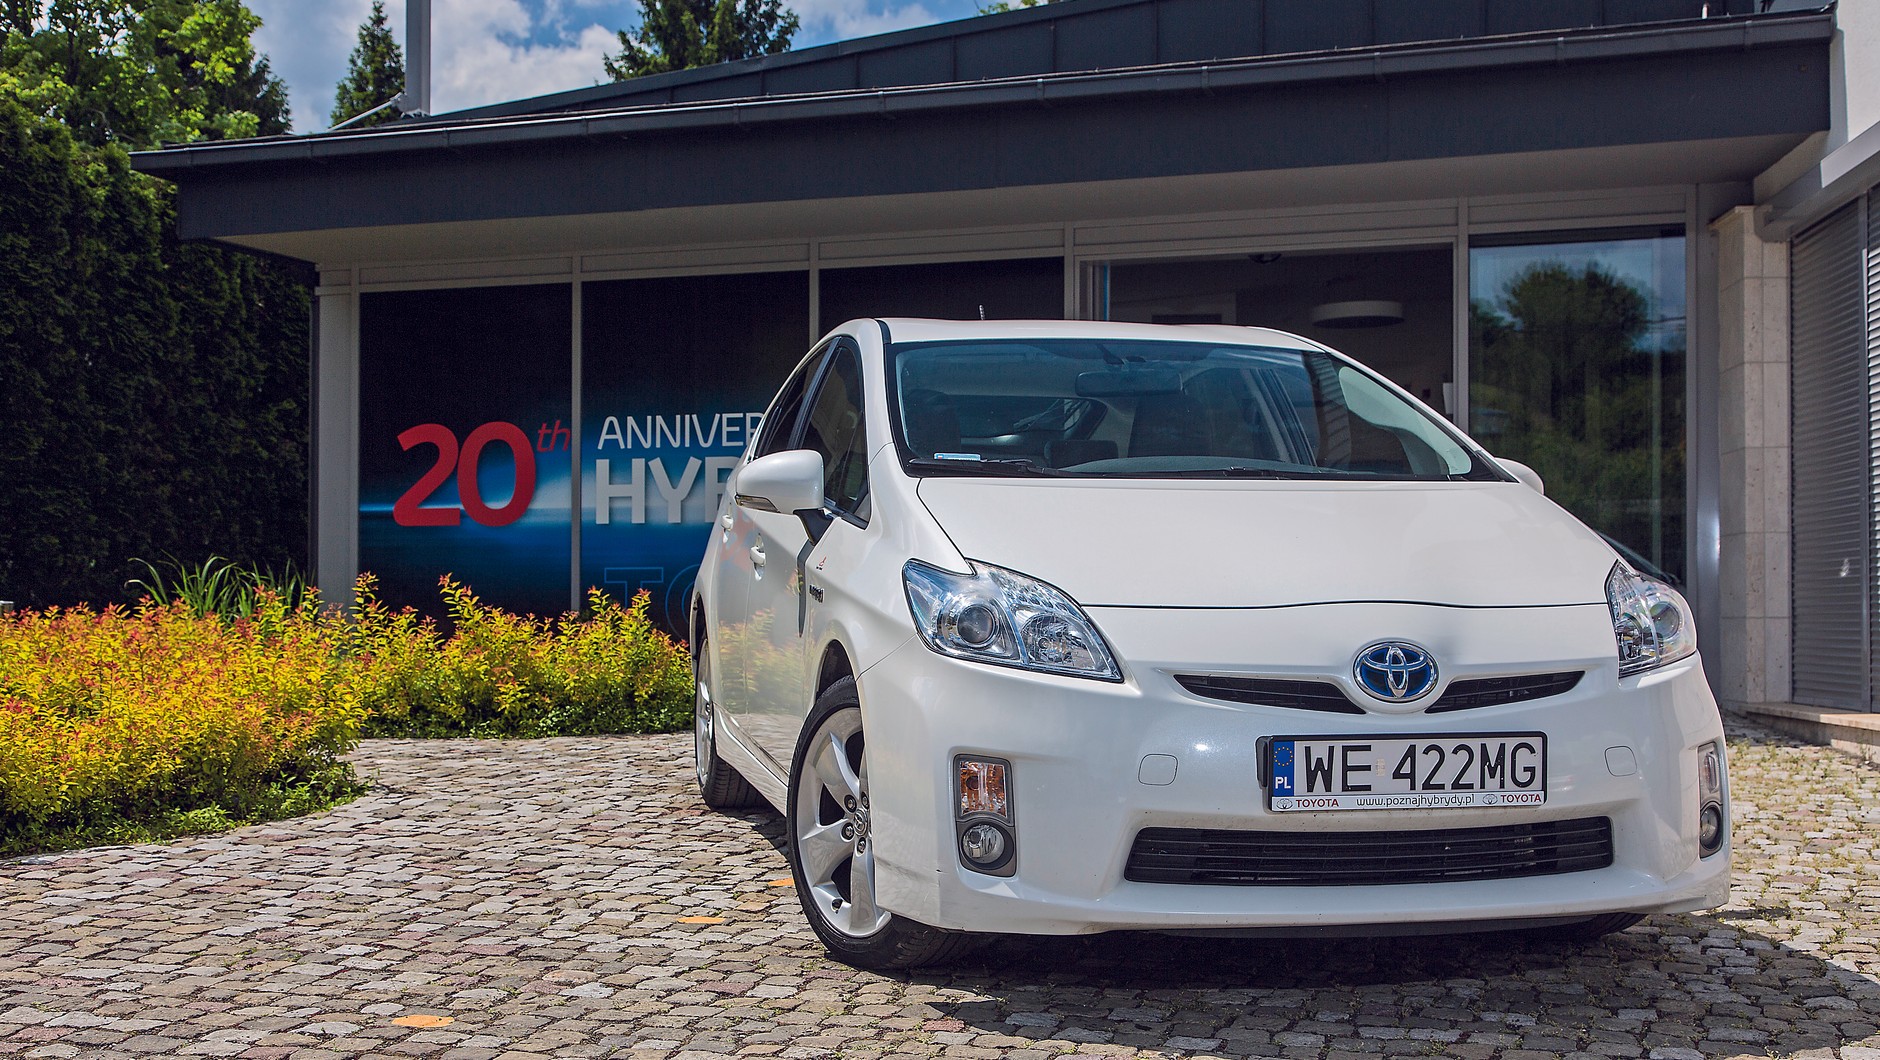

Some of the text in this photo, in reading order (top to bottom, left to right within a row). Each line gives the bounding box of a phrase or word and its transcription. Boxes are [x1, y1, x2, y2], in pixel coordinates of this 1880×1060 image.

[1304, 742, 1536, 792] WE 422MG
[1275, 776, 1291, 789] PL
[1296, 794, 1541, 808] TOYOTA www.poznajhybrydy.pl TOYOTA
